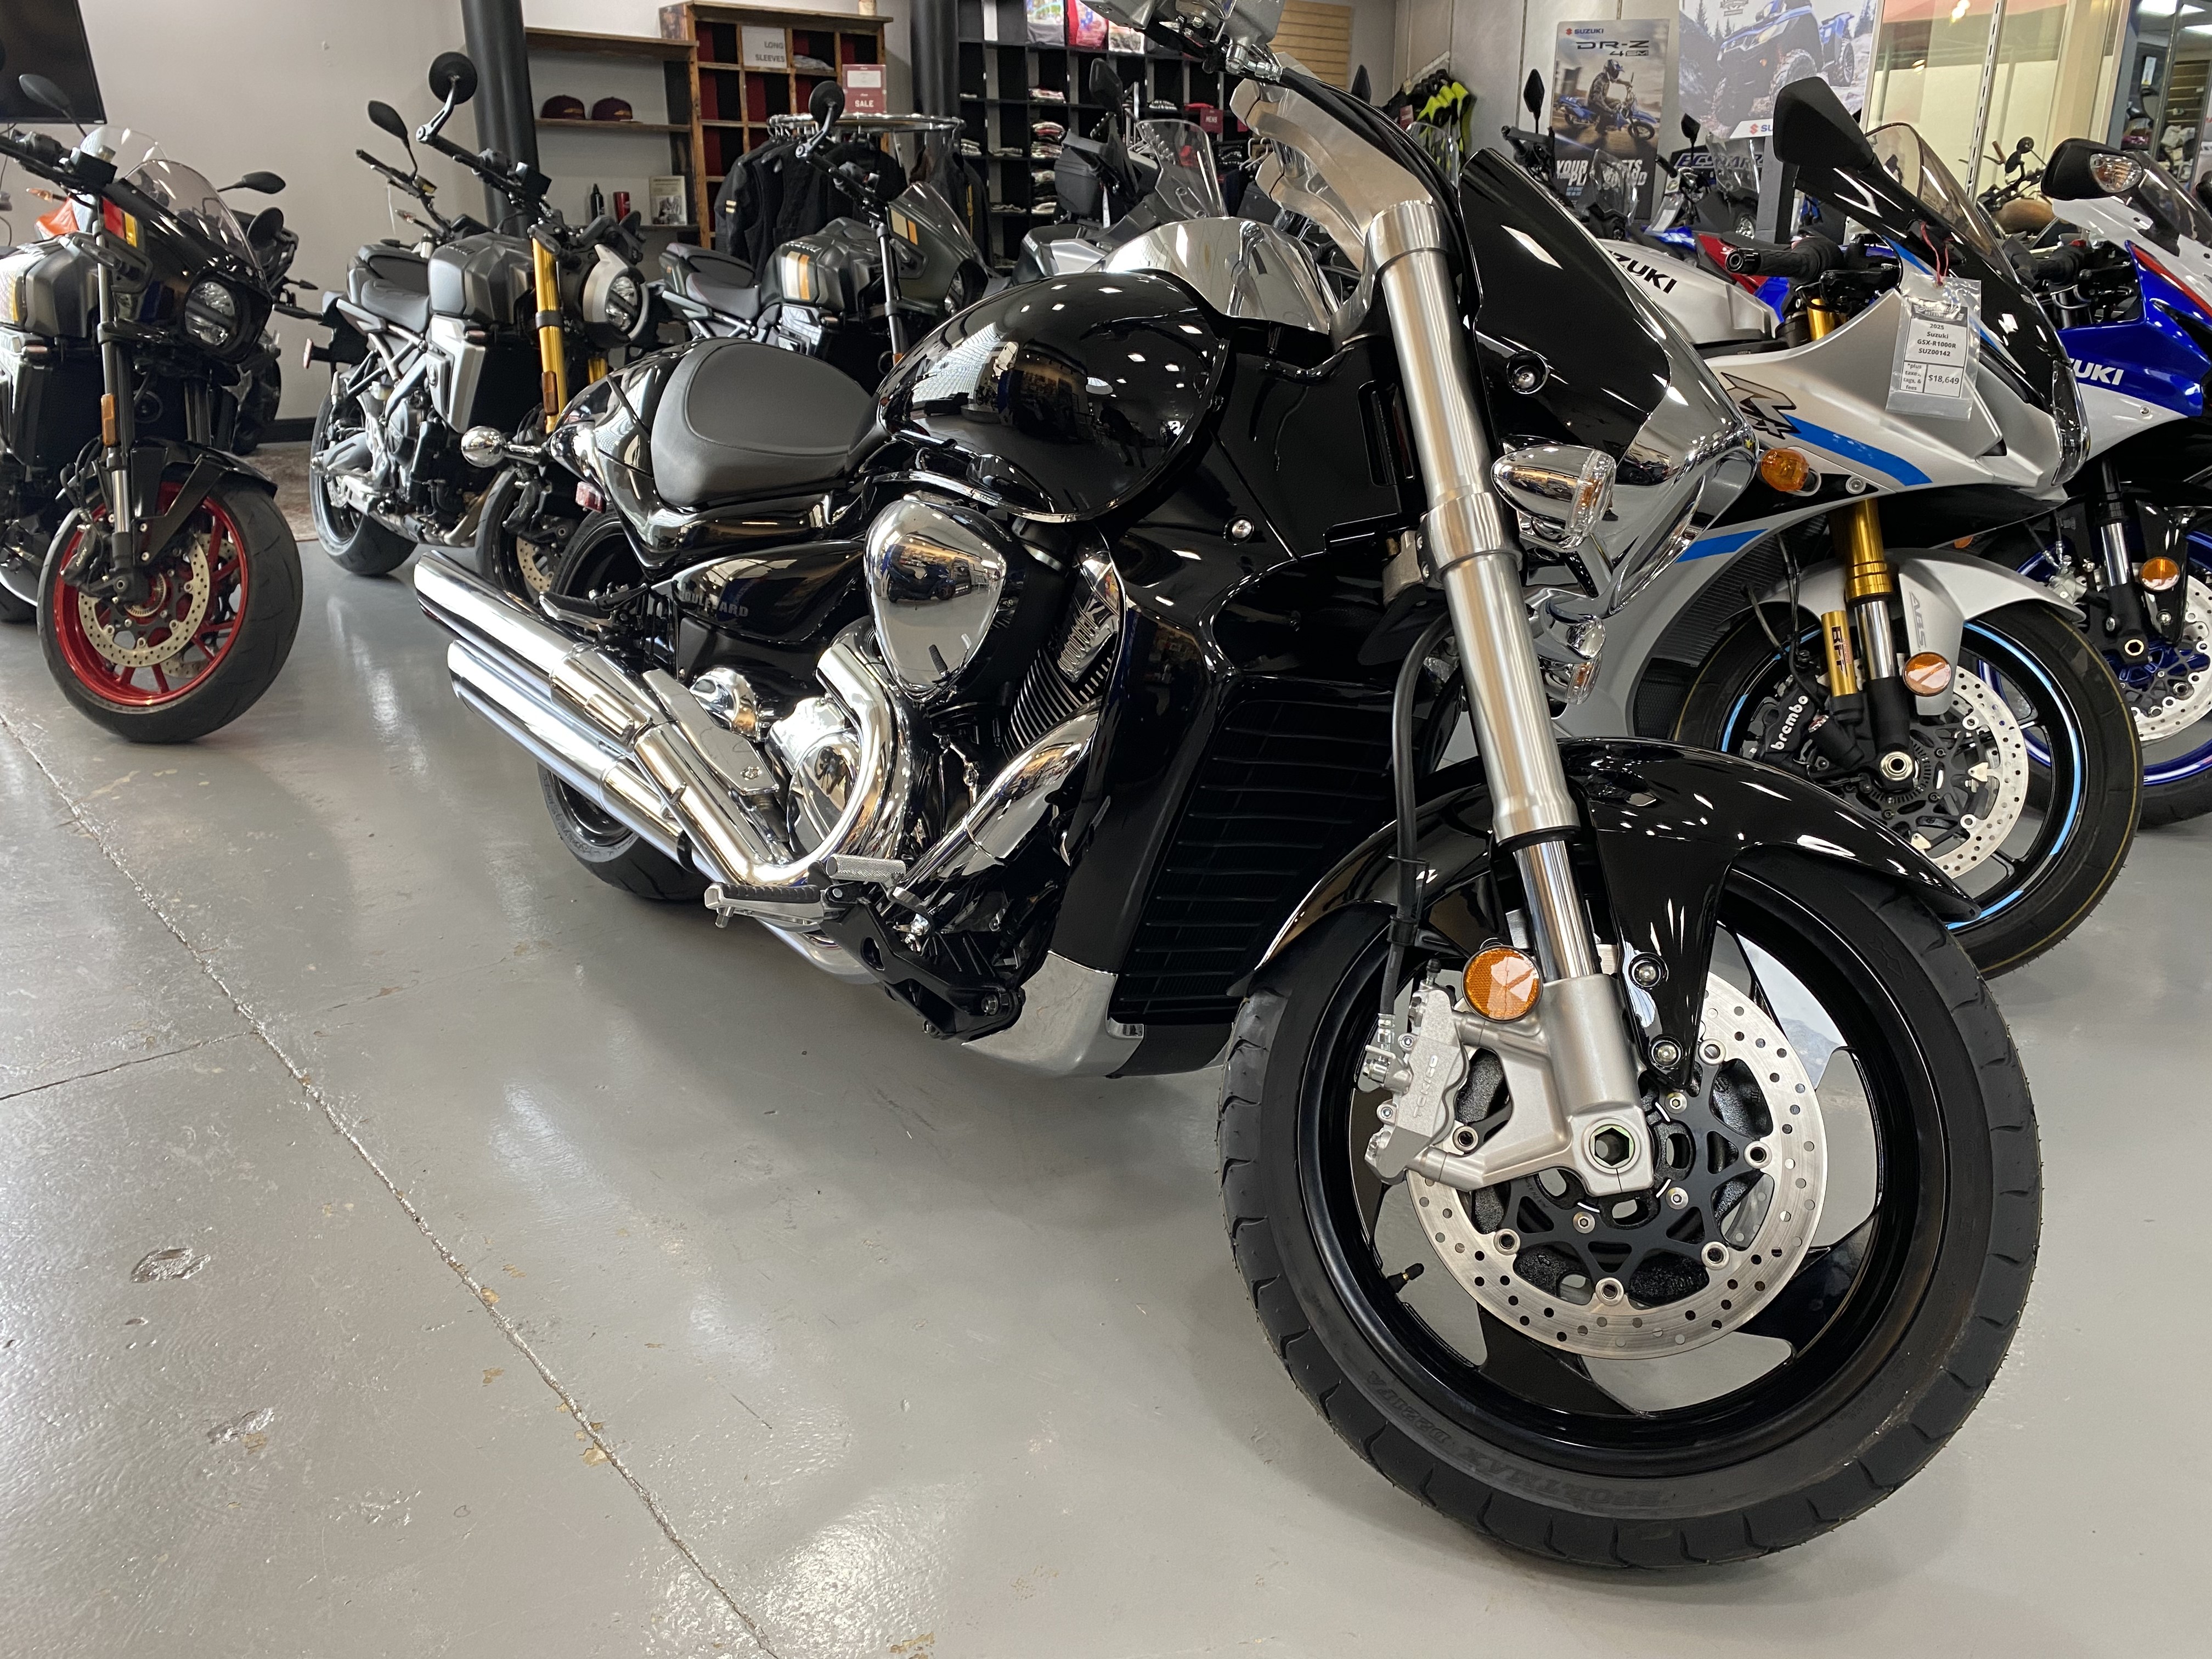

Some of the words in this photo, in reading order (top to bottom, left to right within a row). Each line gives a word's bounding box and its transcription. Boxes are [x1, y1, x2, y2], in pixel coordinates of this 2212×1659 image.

[1576, 40, 1649, 49] DR-Z
[755, 54, 785, 63] SLEEVES
[1556, 160, 1589, 174] YOUR
[1608, 250, 1677, 294] ZUKI
[1917, 339, 1956, 348] GSX-R1000R
[1918, 348, 1950, 357] SUZ00142
[2069, 358, 2124, 385] UKI
[1928, 374, 1959, 384] $18,649
[1770, 695, 1808, 750] brembo
[1413, 1055, 1438, 1118] TOKICO
[1460, 1447, 1662, 1507] SPORTMAX
